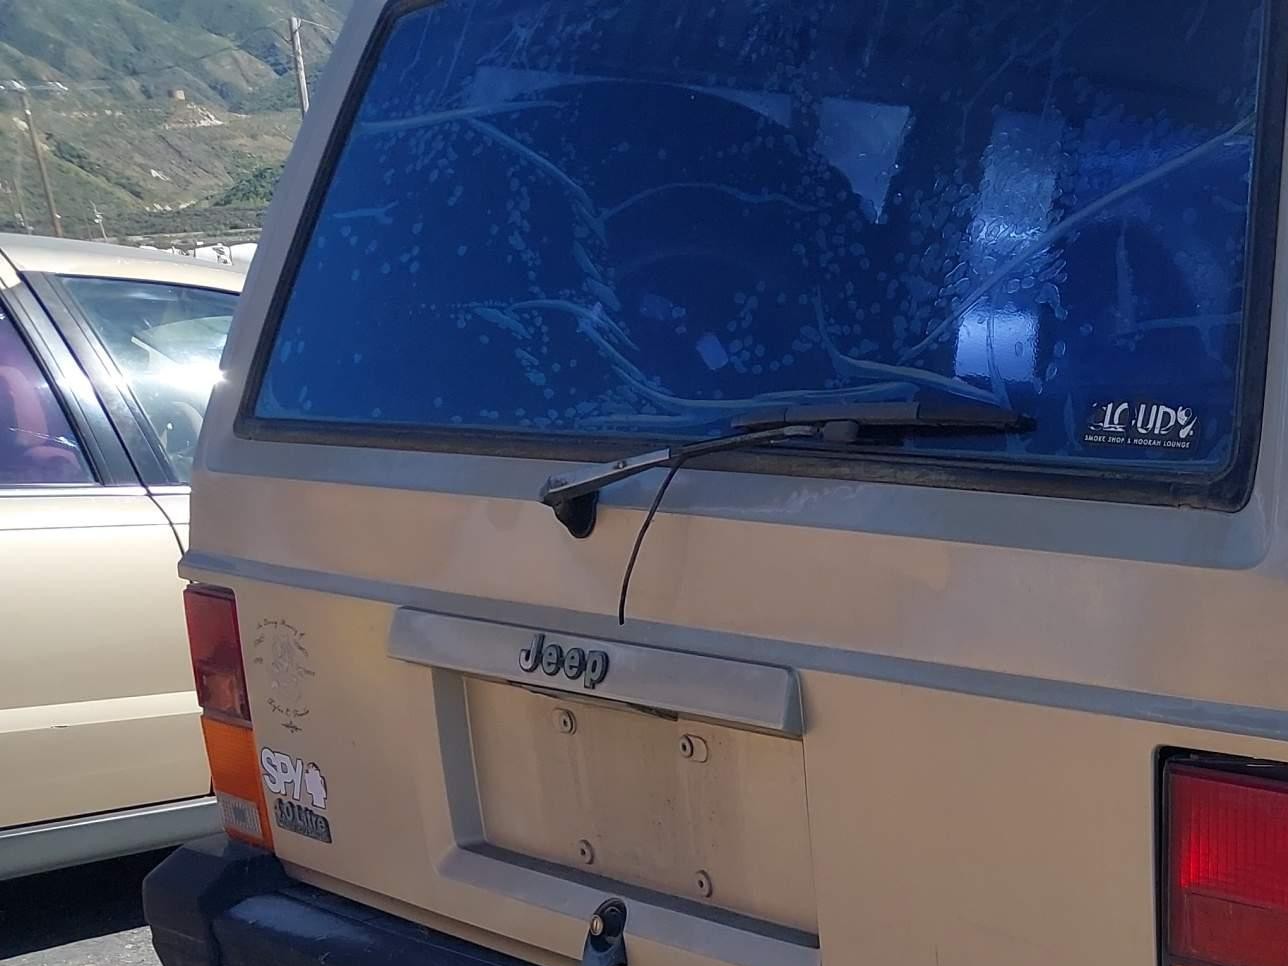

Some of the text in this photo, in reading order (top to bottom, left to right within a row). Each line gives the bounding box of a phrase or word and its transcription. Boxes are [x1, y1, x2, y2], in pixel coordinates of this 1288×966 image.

[1084, 434, 1106, 443] SMOKE
[1107, 436, 1125, 444] SHOP
[1133, 438, 1161, 447] HOOKAH
[1163, 440, 1191, 448] LOUNGE
[518, 633, 610, 690] Jeep
[261, 746, 304, 801] SPY
